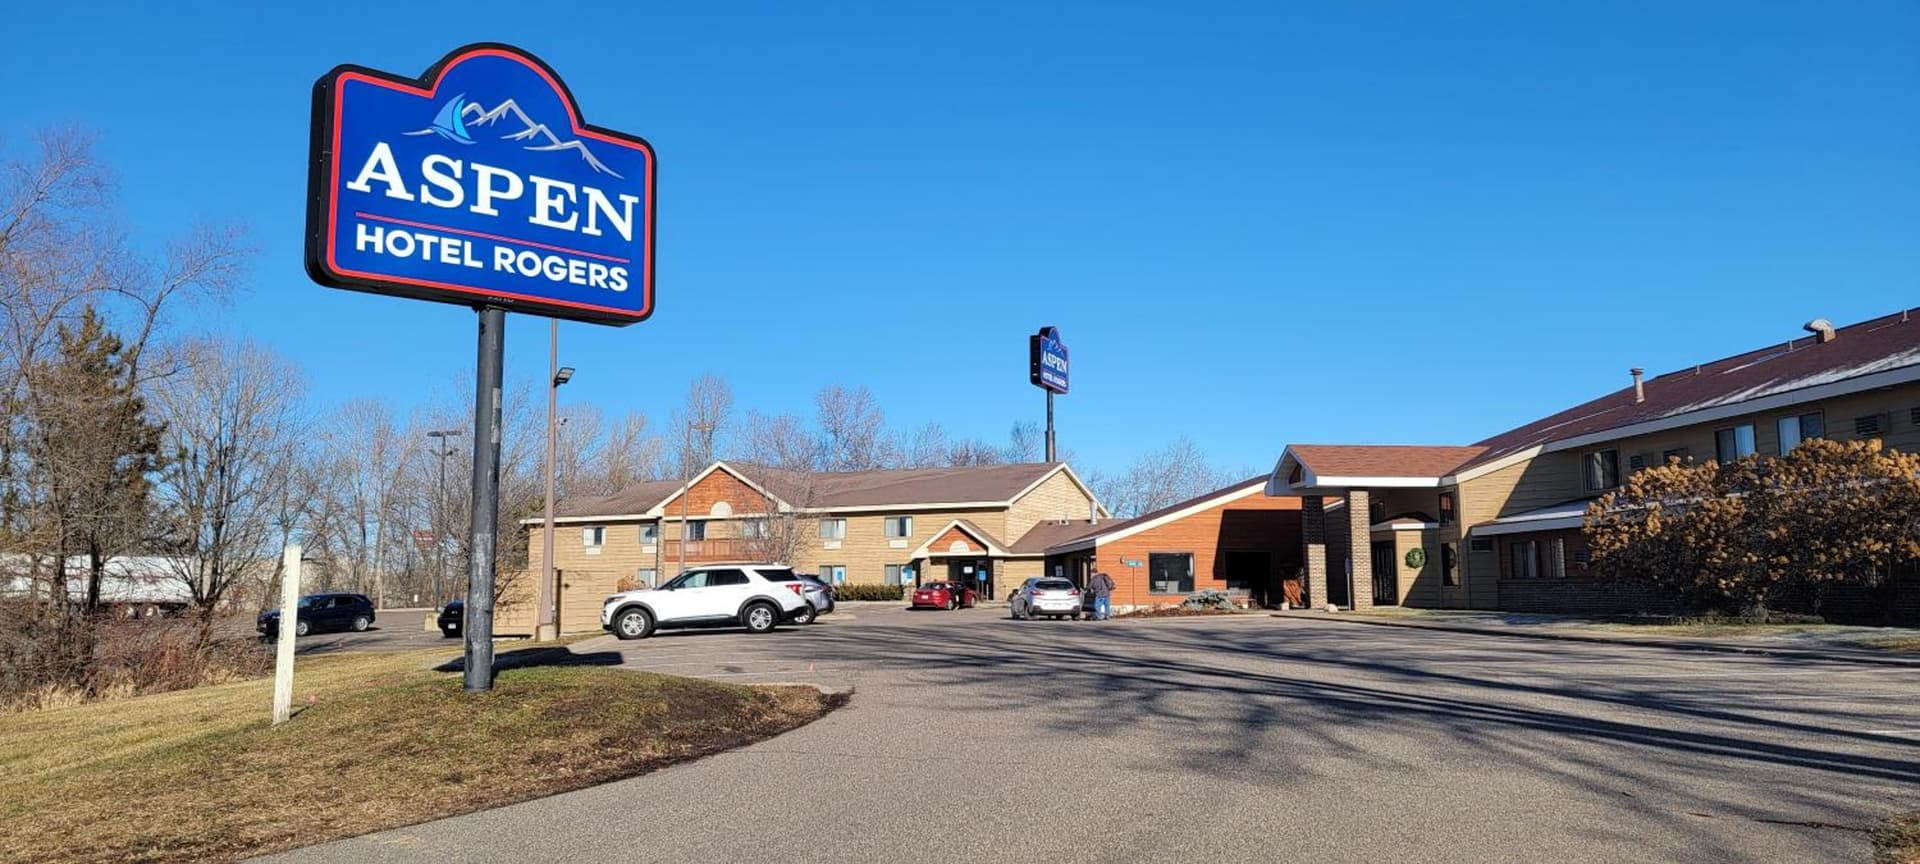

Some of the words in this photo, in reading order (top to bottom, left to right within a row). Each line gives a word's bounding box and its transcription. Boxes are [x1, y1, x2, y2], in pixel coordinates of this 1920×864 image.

[347, 142, 638, 241] ASPEN
[356, 224, 483, 268] HOTEL
[494, 246, 629, 291] ROGERS
[1042, 350, 1067, 374] ASPEN
